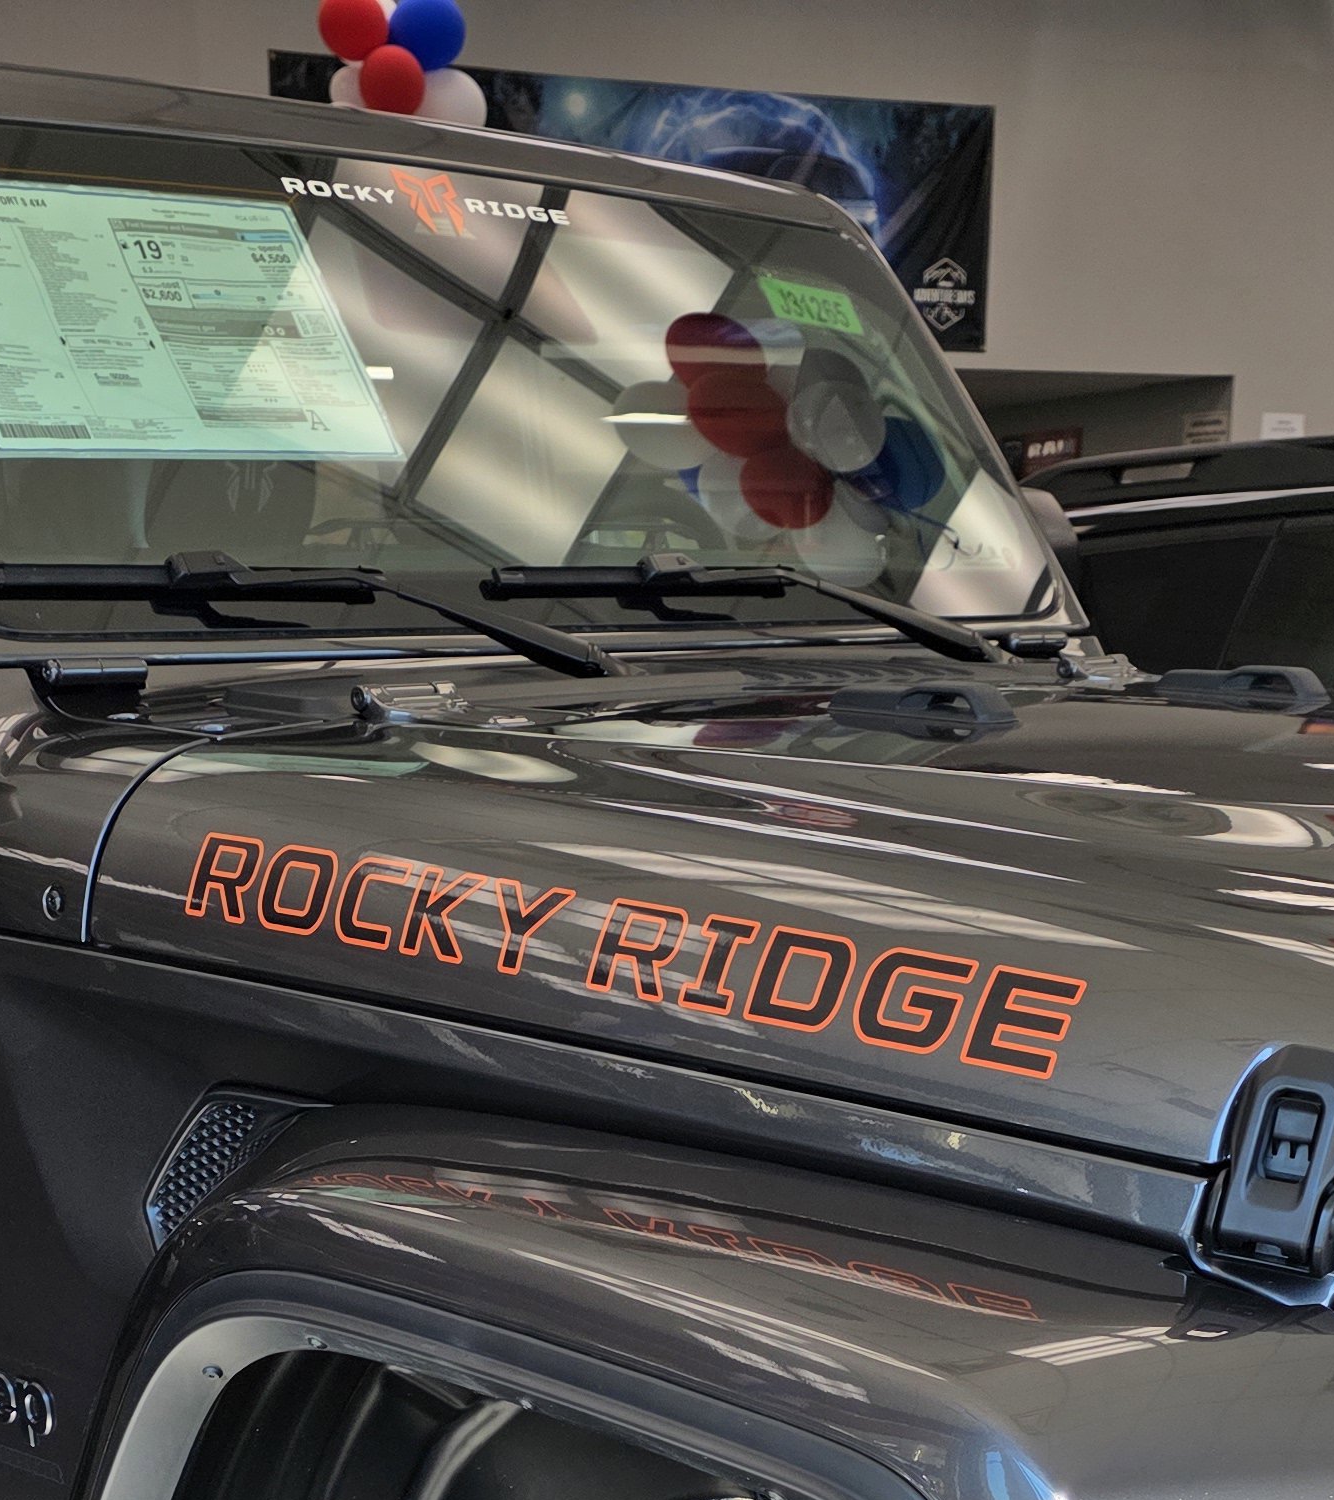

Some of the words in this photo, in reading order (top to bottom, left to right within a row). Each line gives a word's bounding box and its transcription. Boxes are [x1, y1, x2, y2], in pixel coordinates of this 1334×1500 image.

[281, 176, 395, 205] ROCKY
[463, 198, 571, 226] RIDGE
[133, 239, 163, 260] 19
[251, 252, 292, 265] $4,500
[184, 832, 575, 974] ROCKY
[585, 897, 1087, 1079] RIDGE
